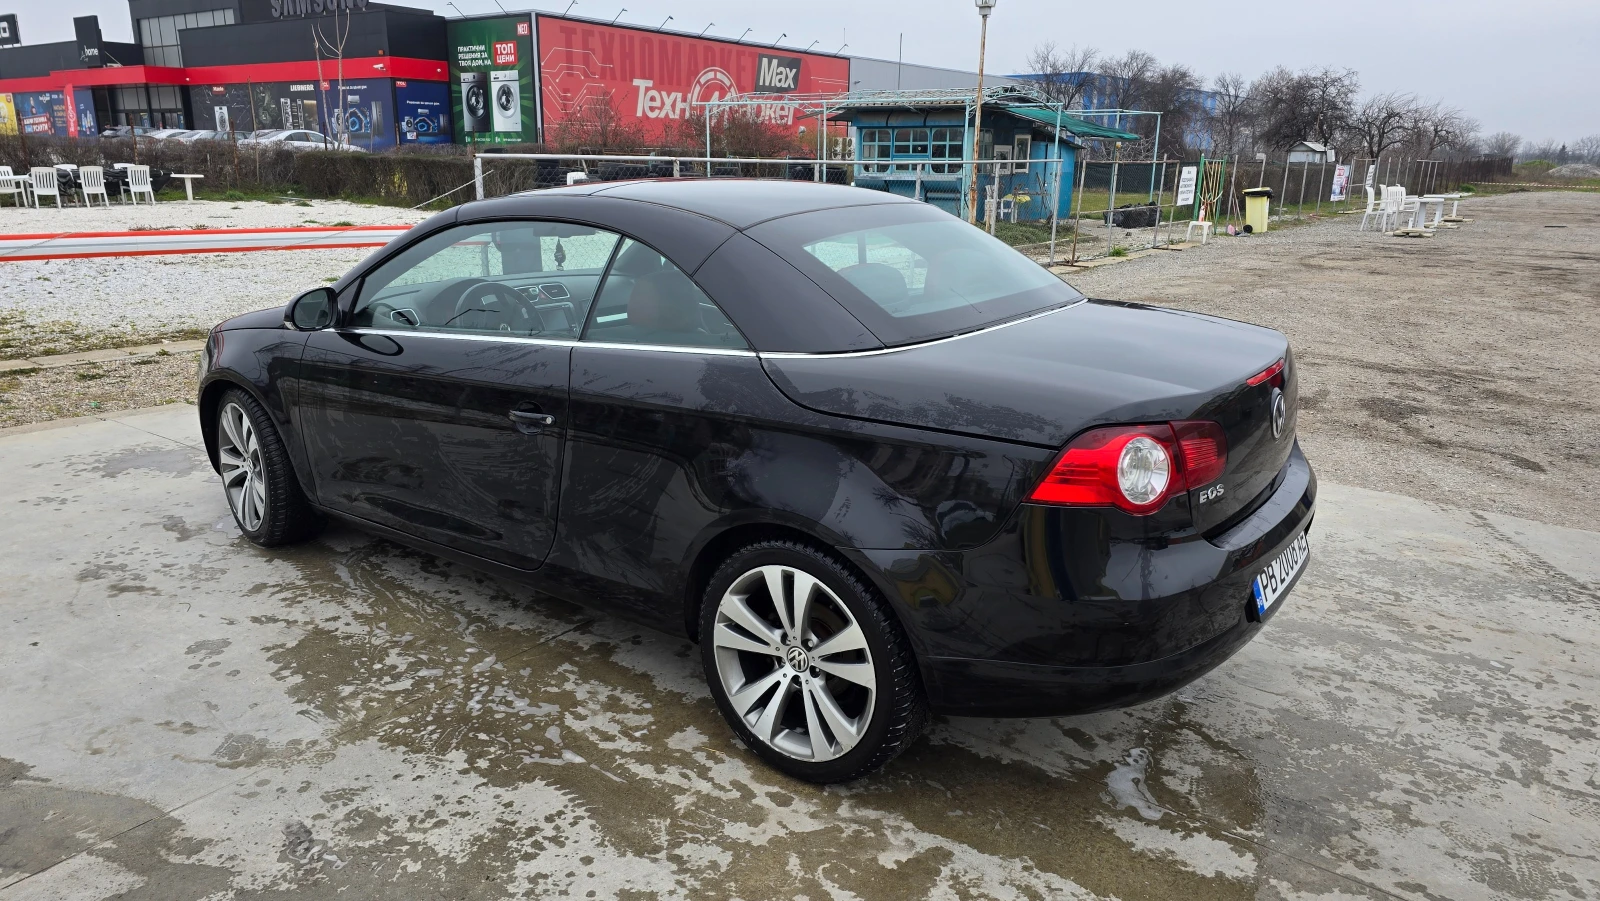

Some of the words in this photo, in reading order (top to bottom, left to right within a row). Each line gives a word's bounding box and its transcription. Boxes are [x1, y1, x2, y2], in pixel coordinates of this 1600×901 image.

[517, 24, 528, 35] NEO
[496, 43, 514, 54] ТОП
[497, 55, 514, 64] ЦЕНИ
[759, 55, 797, 89] Max
[1200, 484, 1225, 504] EOS
[1260, 563, 1278, 602] PB
